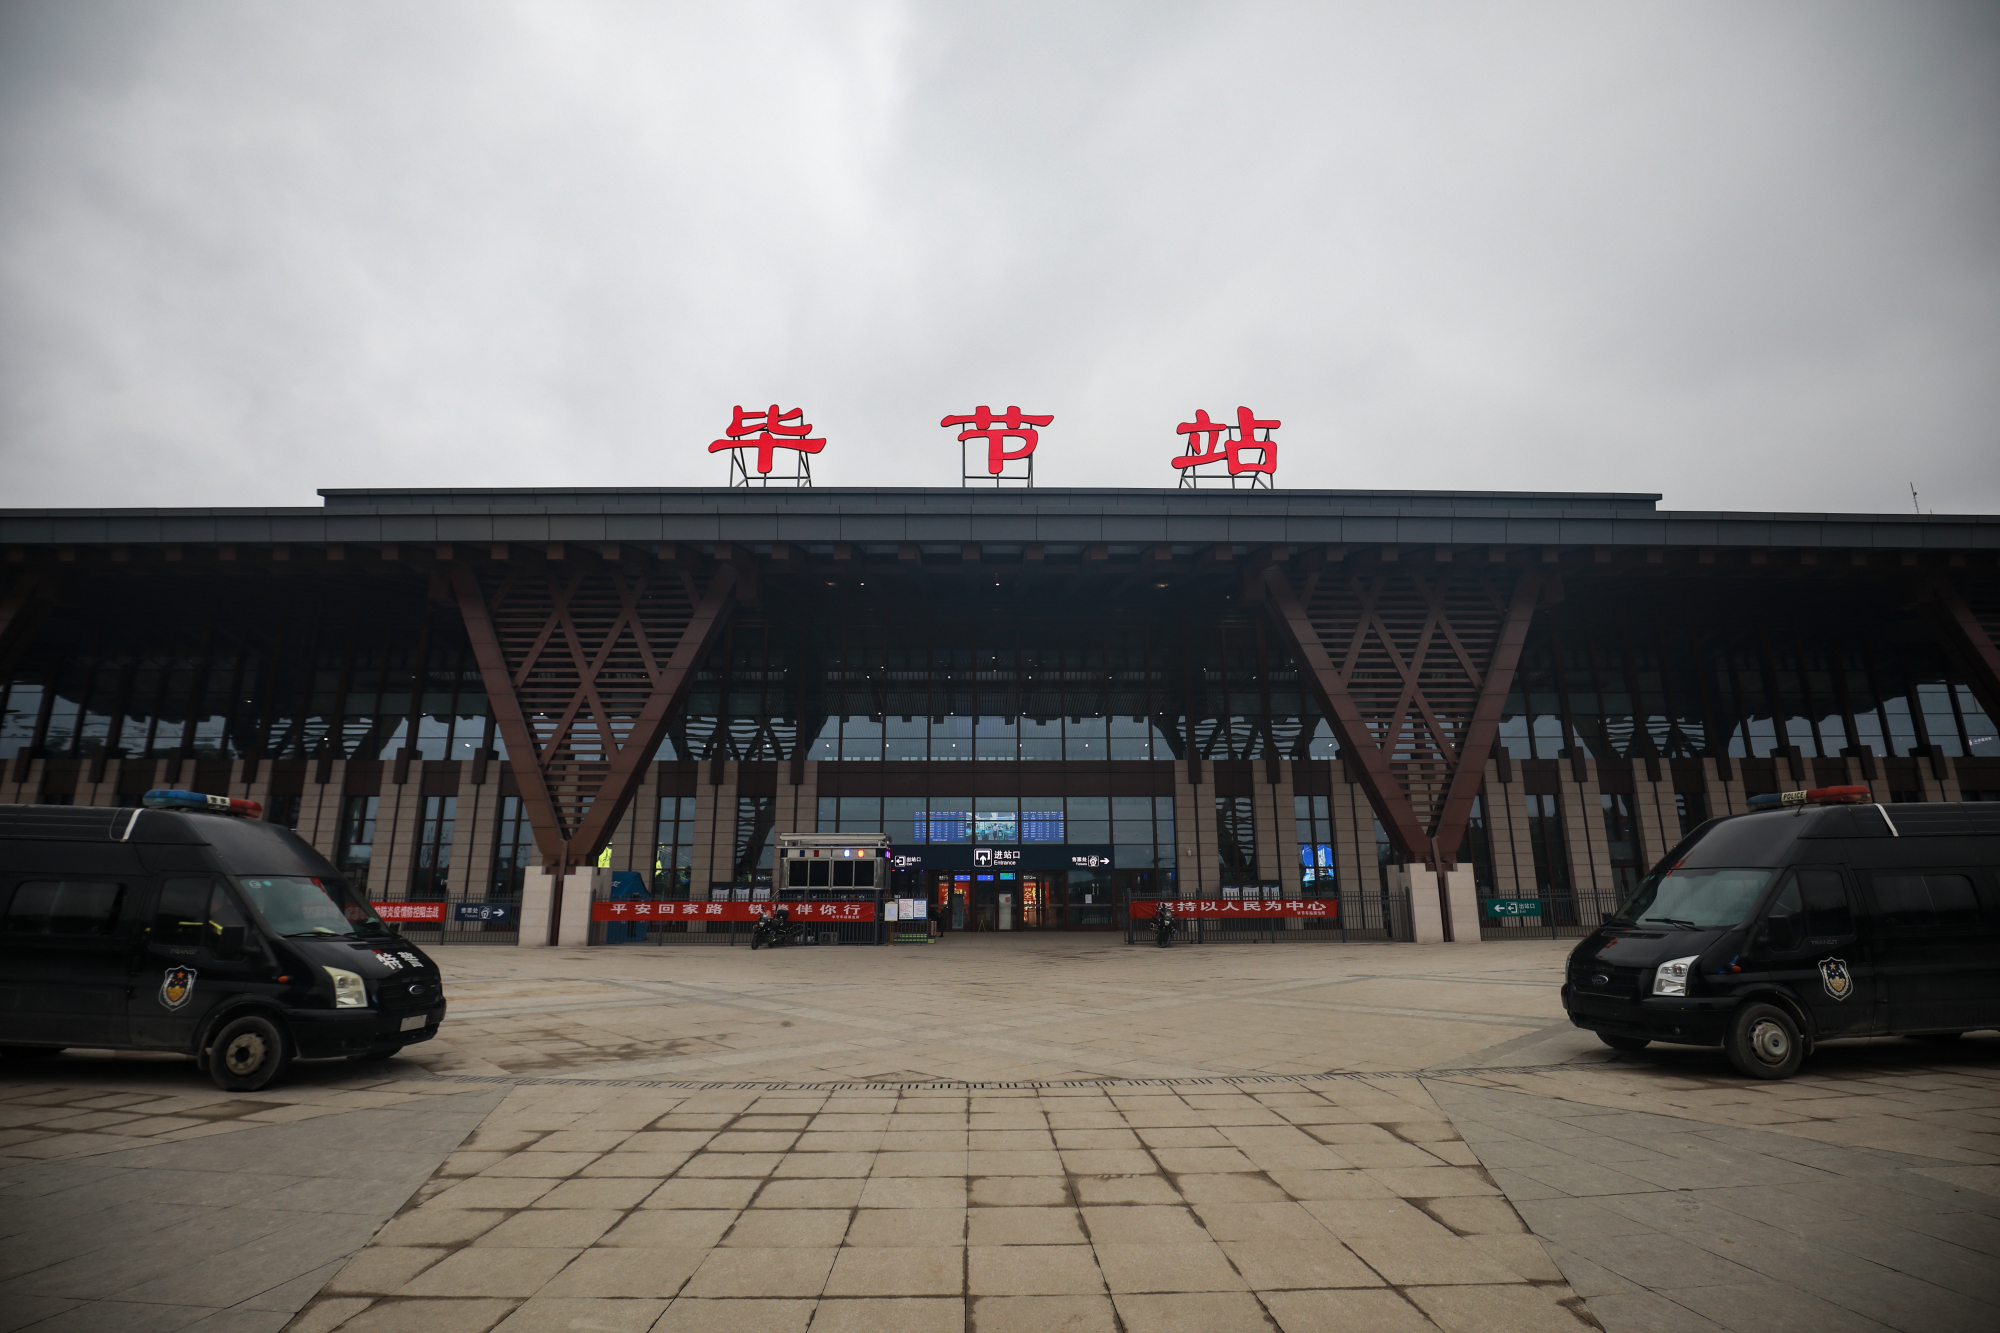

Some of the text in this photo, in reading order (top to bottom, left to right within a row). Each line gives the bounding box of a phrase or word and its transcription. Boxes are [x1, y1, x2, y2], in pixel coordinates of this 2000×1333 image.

[708, 404, 1281, 475] 毕节站
[1783, 792, 1804, 800] POLICE
[993, 850, 1021, 860] 进站口
[610, 903, 723, 915] 平安回家路
[1158, 900, 1326, 912] 坚持以人民为中心
[375, 951, 425, 970] 特警
